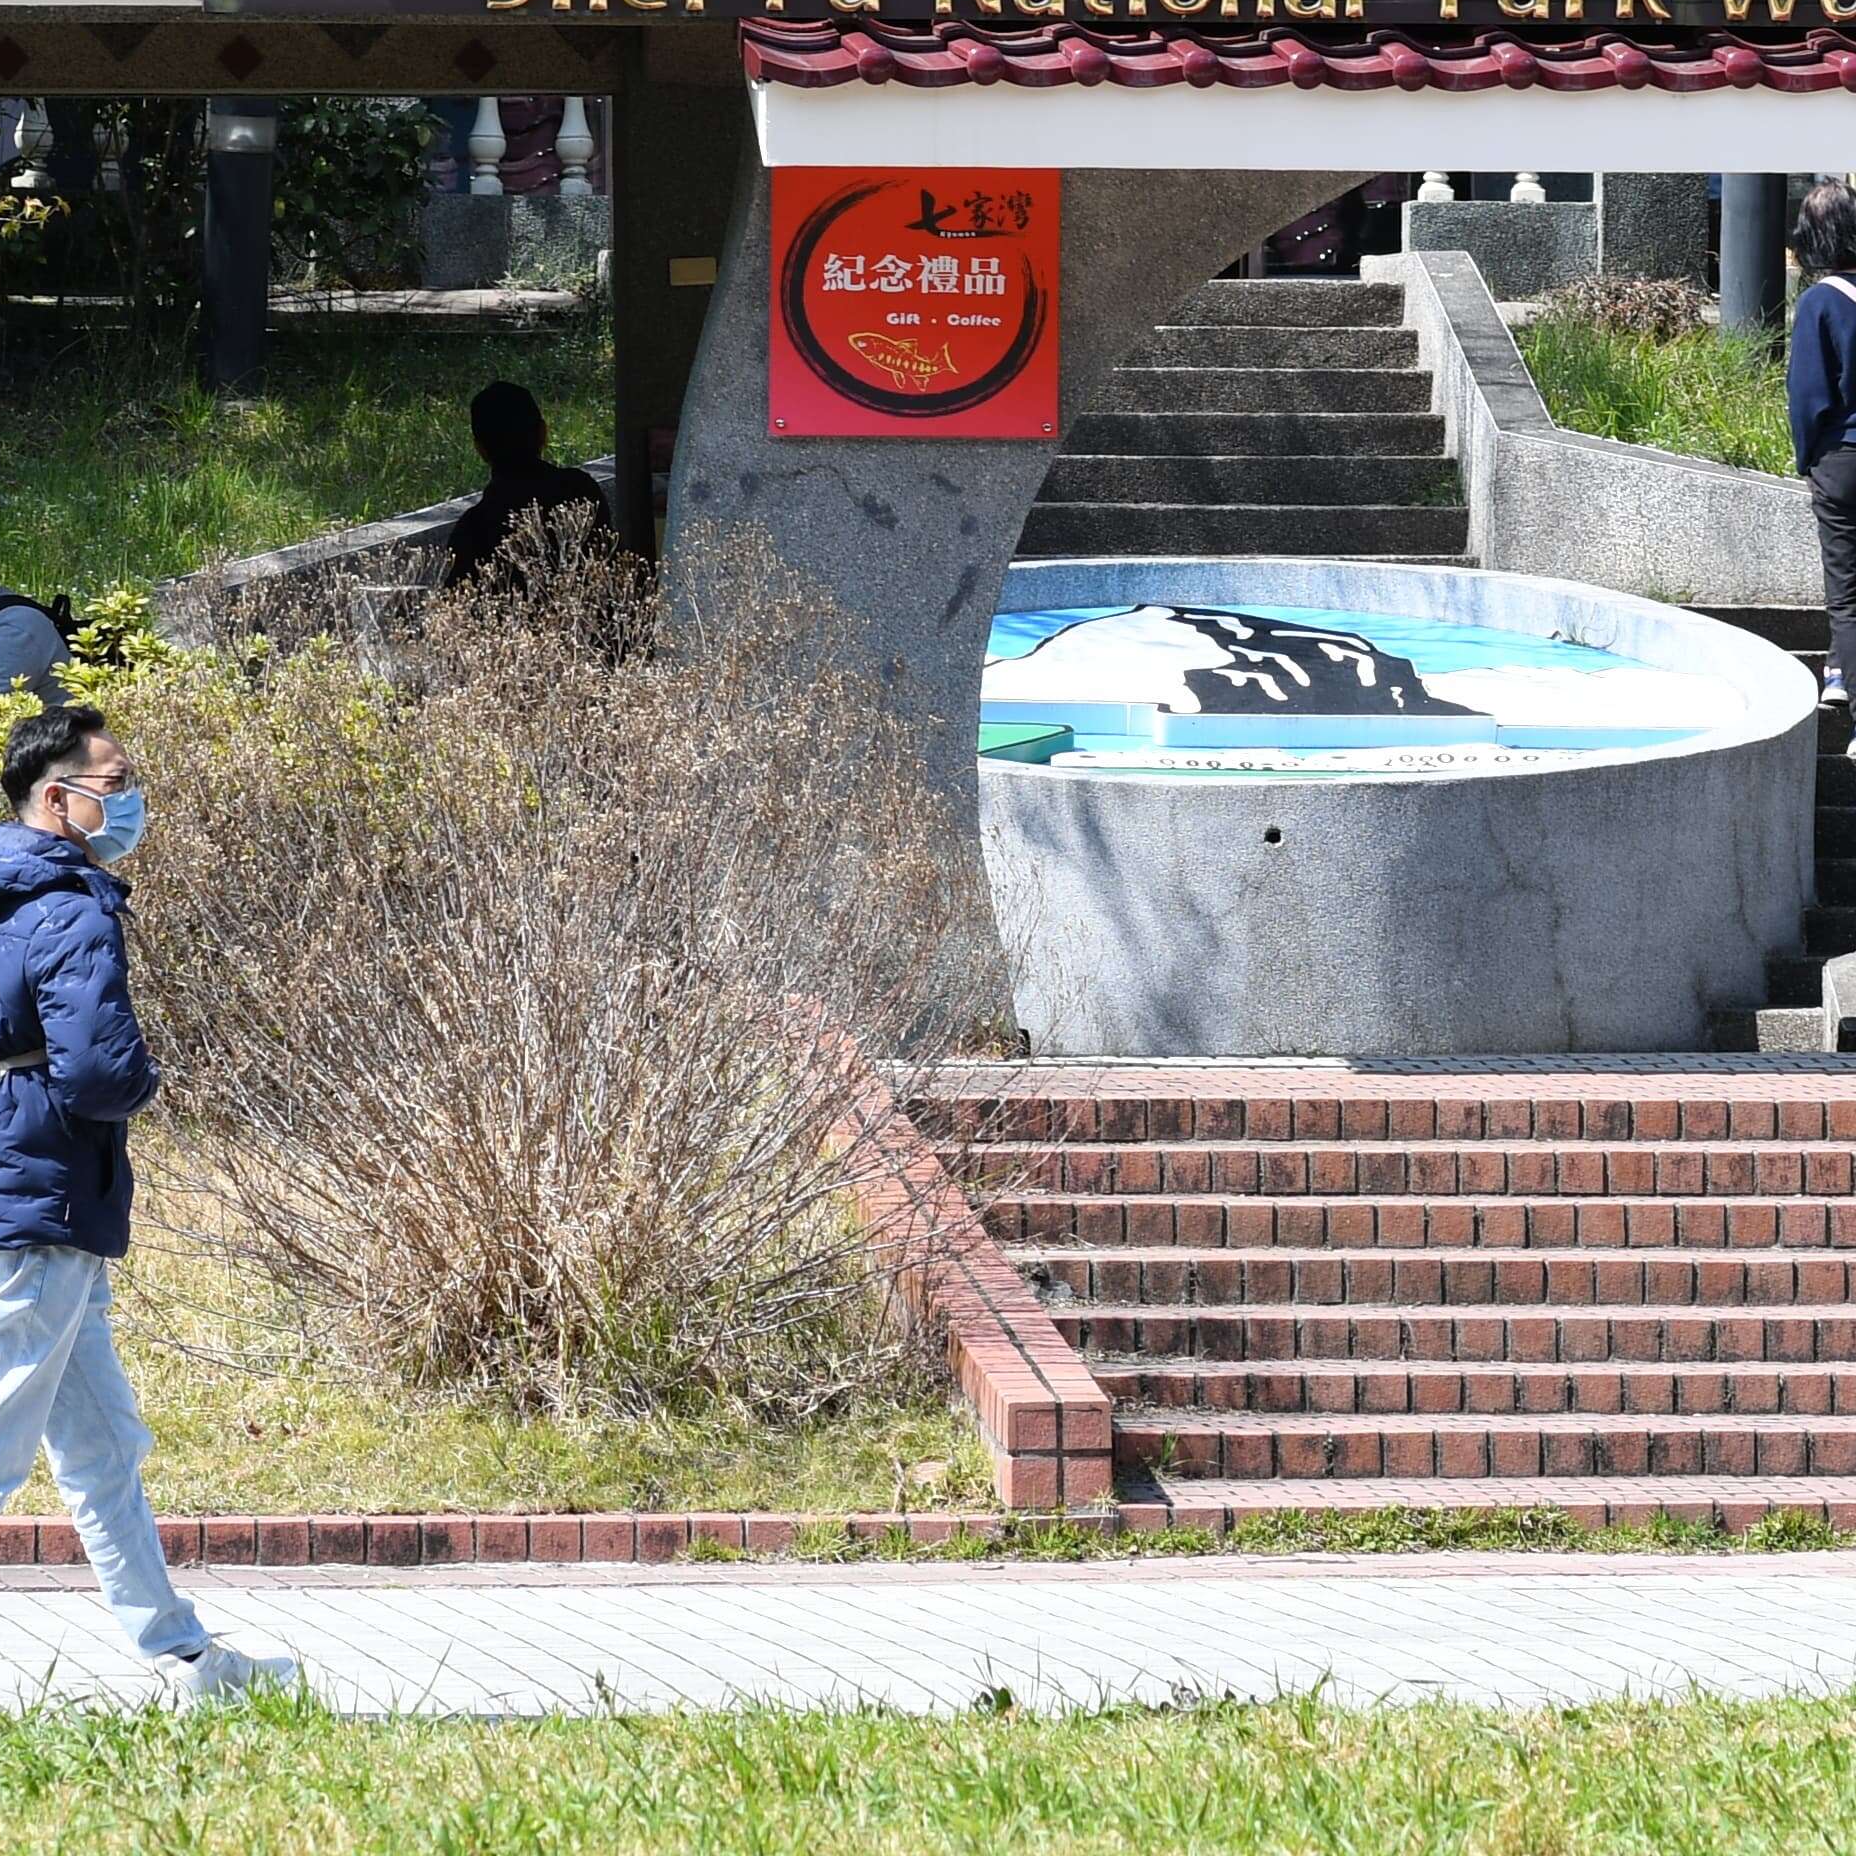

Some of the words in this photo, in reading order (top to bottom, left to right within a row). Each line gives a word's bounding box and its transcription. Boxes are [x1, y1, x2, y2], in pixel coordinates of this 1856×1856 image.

[904, 189, 1032, 236] 七家灣
[822, 254, 1007, 295] 紀念禮品
[886, 313, 921, 325] Gift
[947, 314, 1002, 327] Coffee
